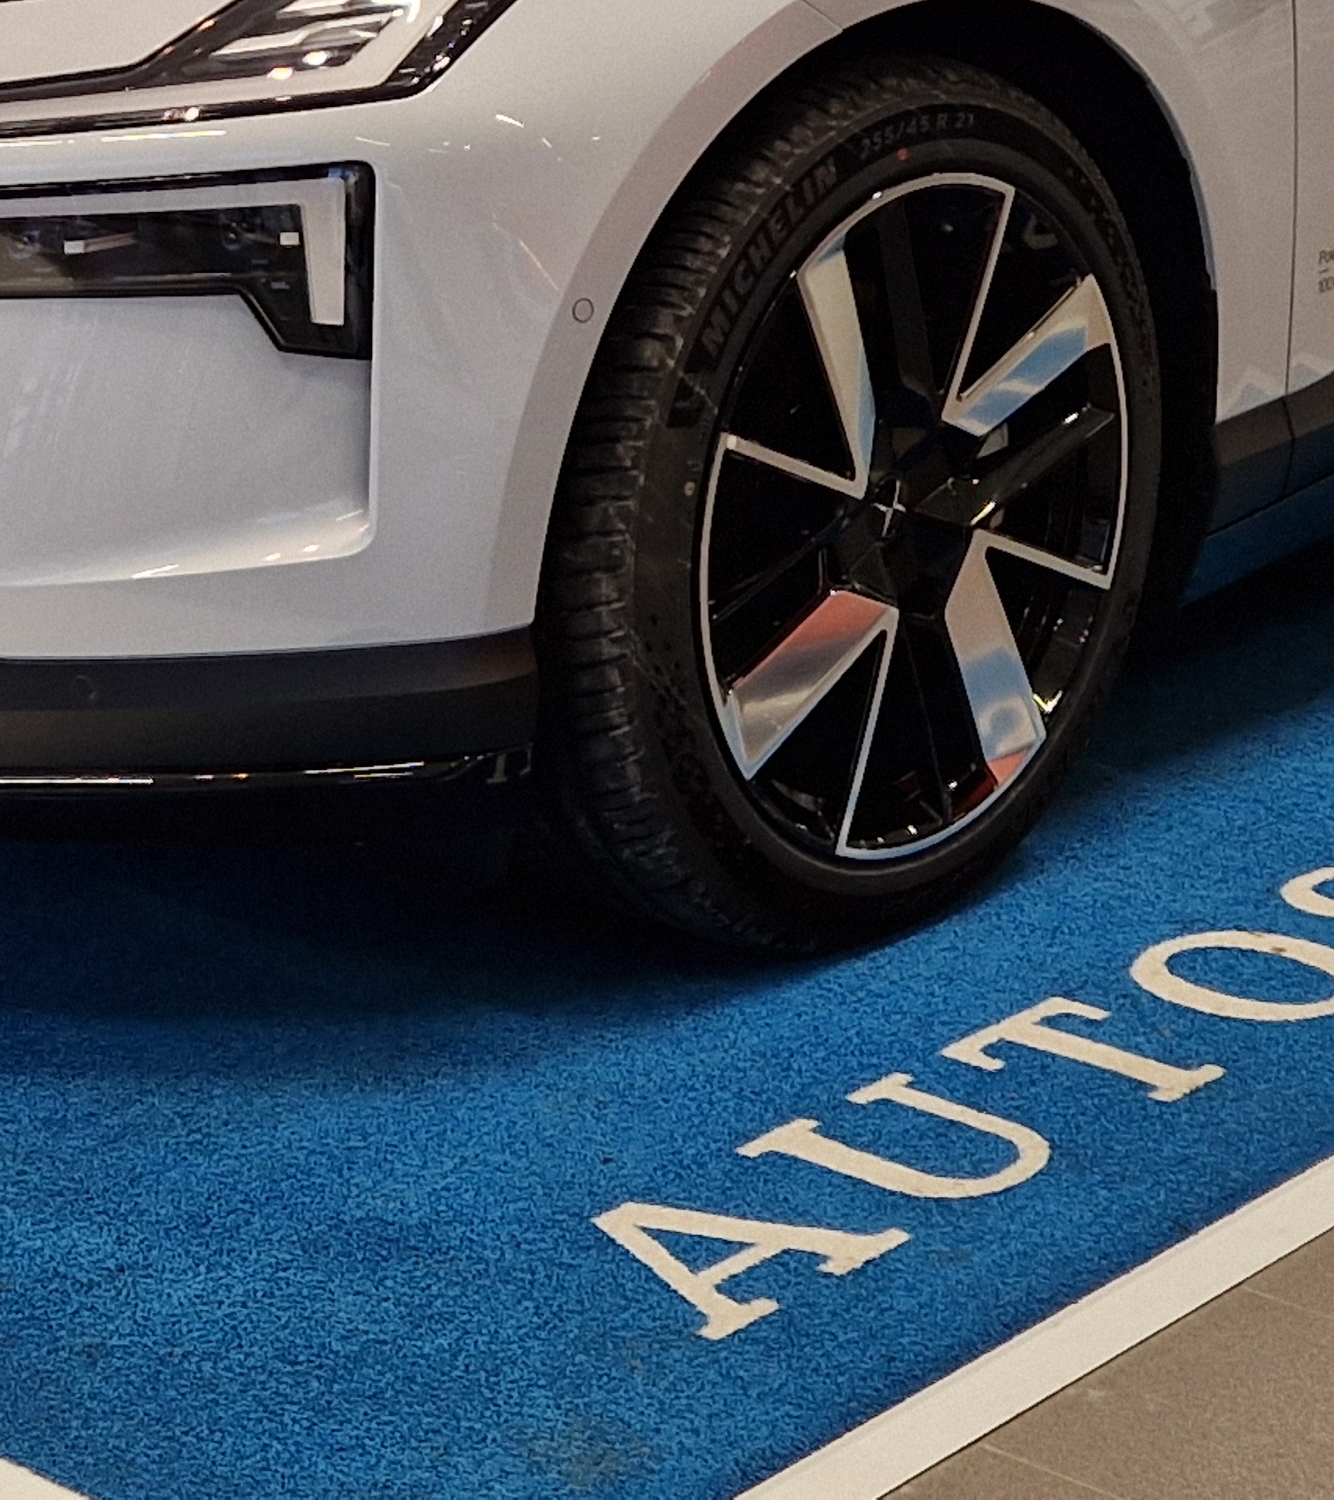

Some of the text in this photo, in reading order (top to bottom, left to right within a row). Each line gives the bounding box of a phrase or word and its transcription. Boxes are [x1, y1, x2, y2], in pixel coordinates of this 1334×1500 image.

[860, 113, 931, 161] 255/45
[935, 112, 949, 131] R
[701, 155, 838, 360] MICHELIN
